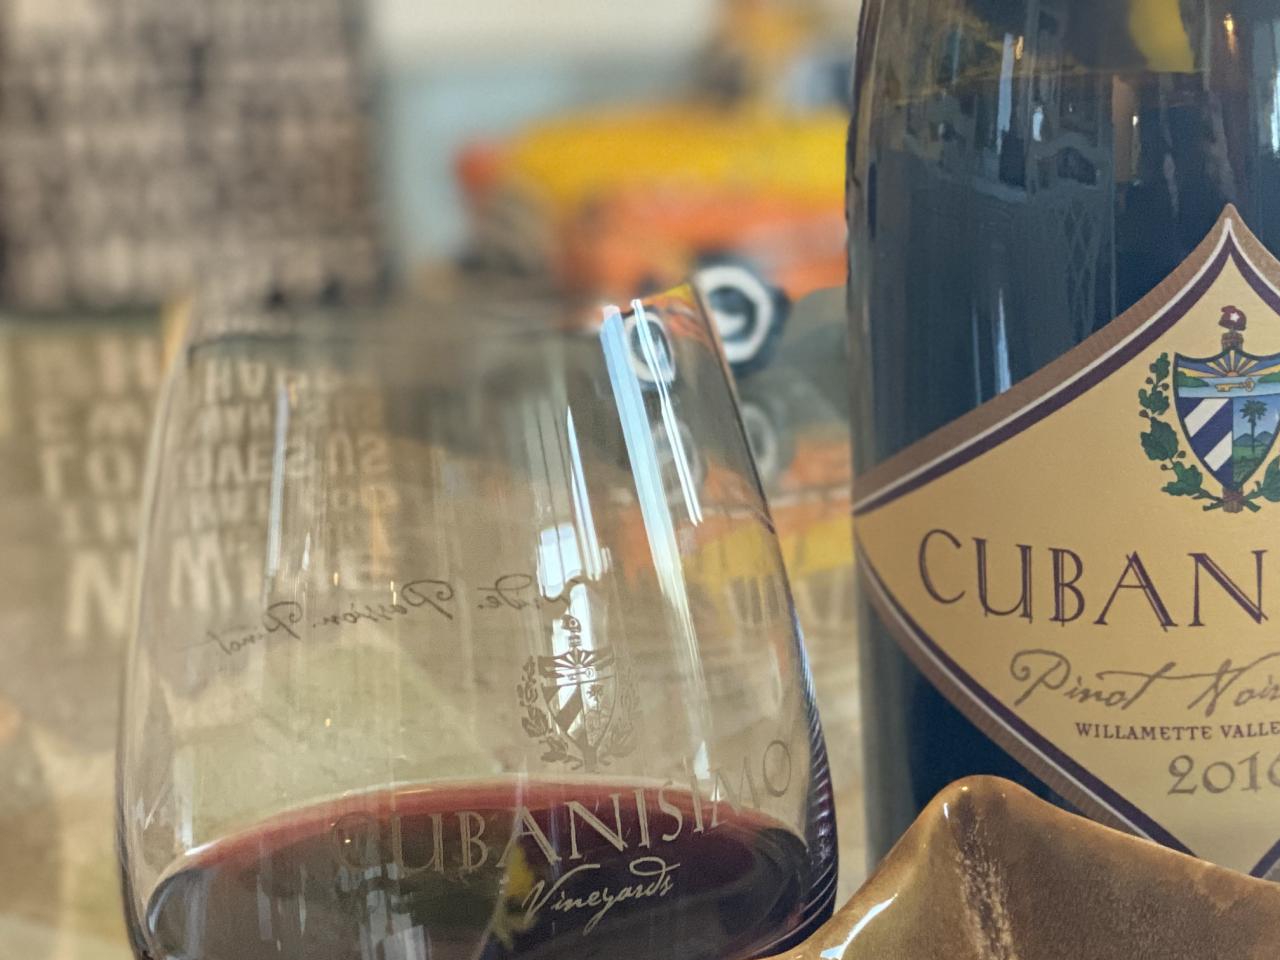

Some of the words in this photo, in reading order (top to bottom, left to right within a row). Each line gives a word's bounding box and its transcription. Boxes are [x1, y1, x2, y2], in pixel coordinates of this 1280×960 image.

[1010, 648, 1177, 712] Pinot
[1075, 722, 1213, 741] WILLAMETTE
[334, 739, 793, 876] CUBANISIMO
[521, 856, 681, 936] Vineyards
